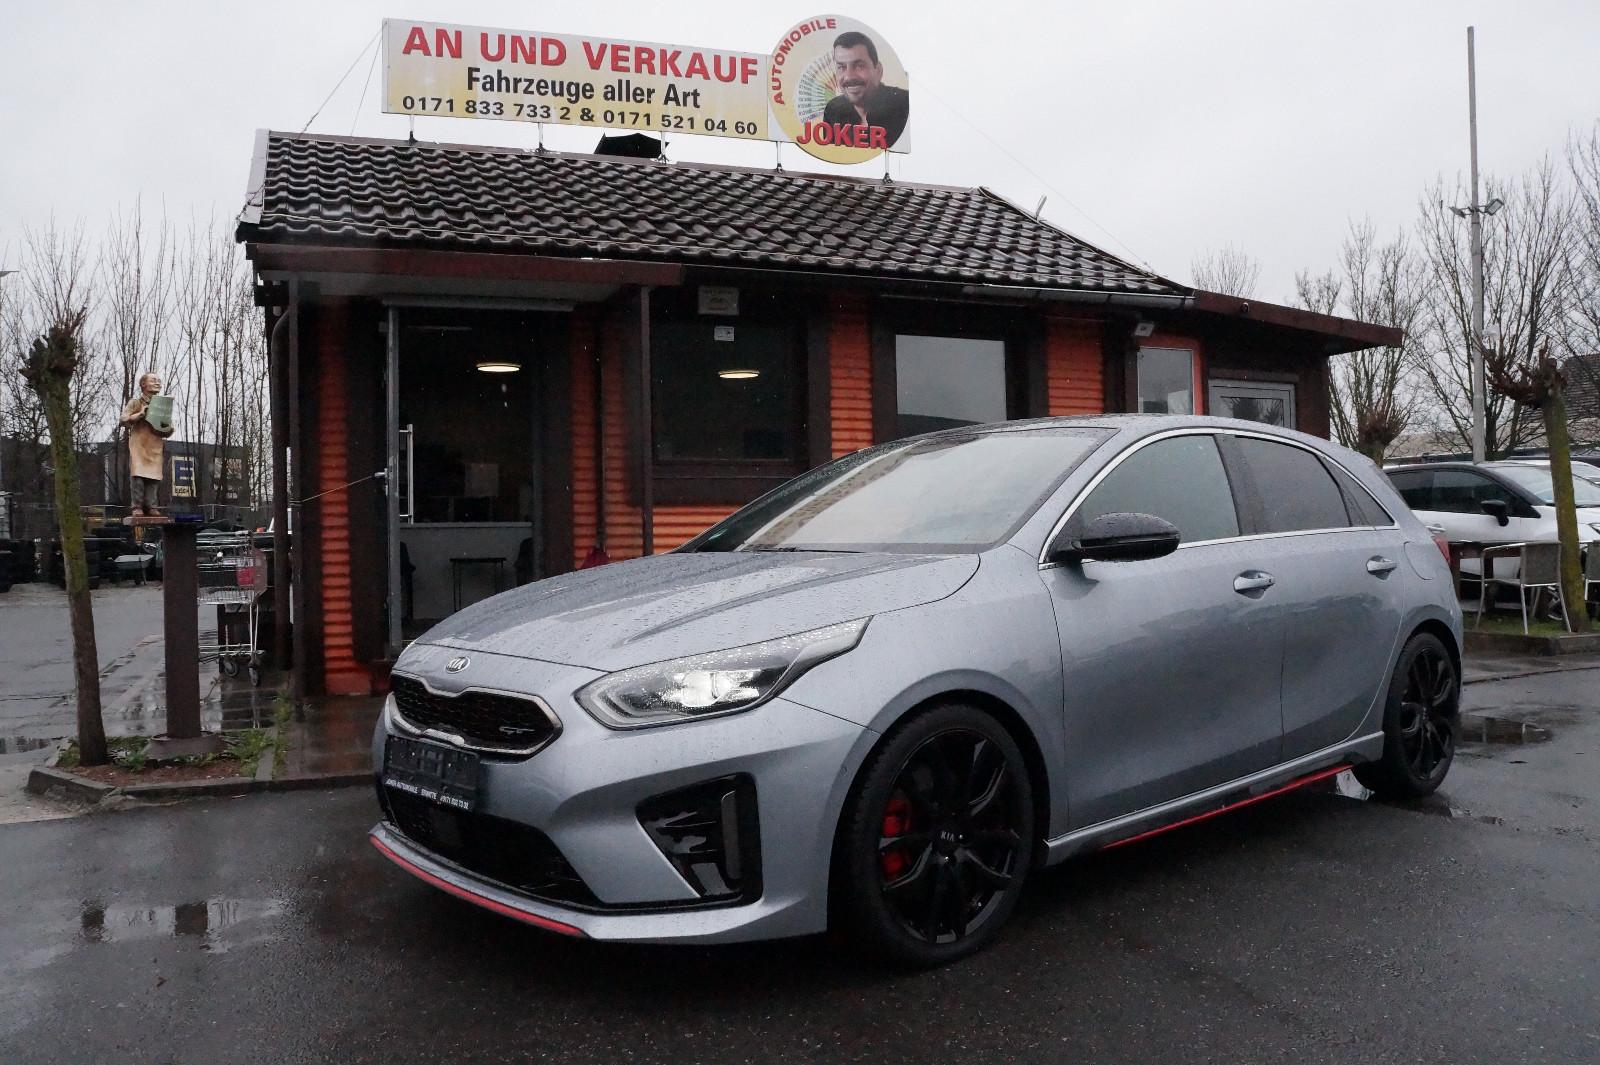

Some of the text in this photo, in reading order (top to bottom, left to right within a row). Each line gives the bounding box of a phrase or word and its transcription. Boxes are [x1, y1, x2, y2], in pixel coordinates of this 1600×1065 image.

[402, 27, 758, 84] AN UND VERKAUF
[771, 18, 837, 105] AUTOMOBILE
[467, 67, 701, 109] Fahrzeuge aller Art
[402, 95, 758, 136] 0171 833 733 2 & 0171 521 04 60
[796, 120, 888, 150] JOKER
[940, 830, 954, 842] KIA
